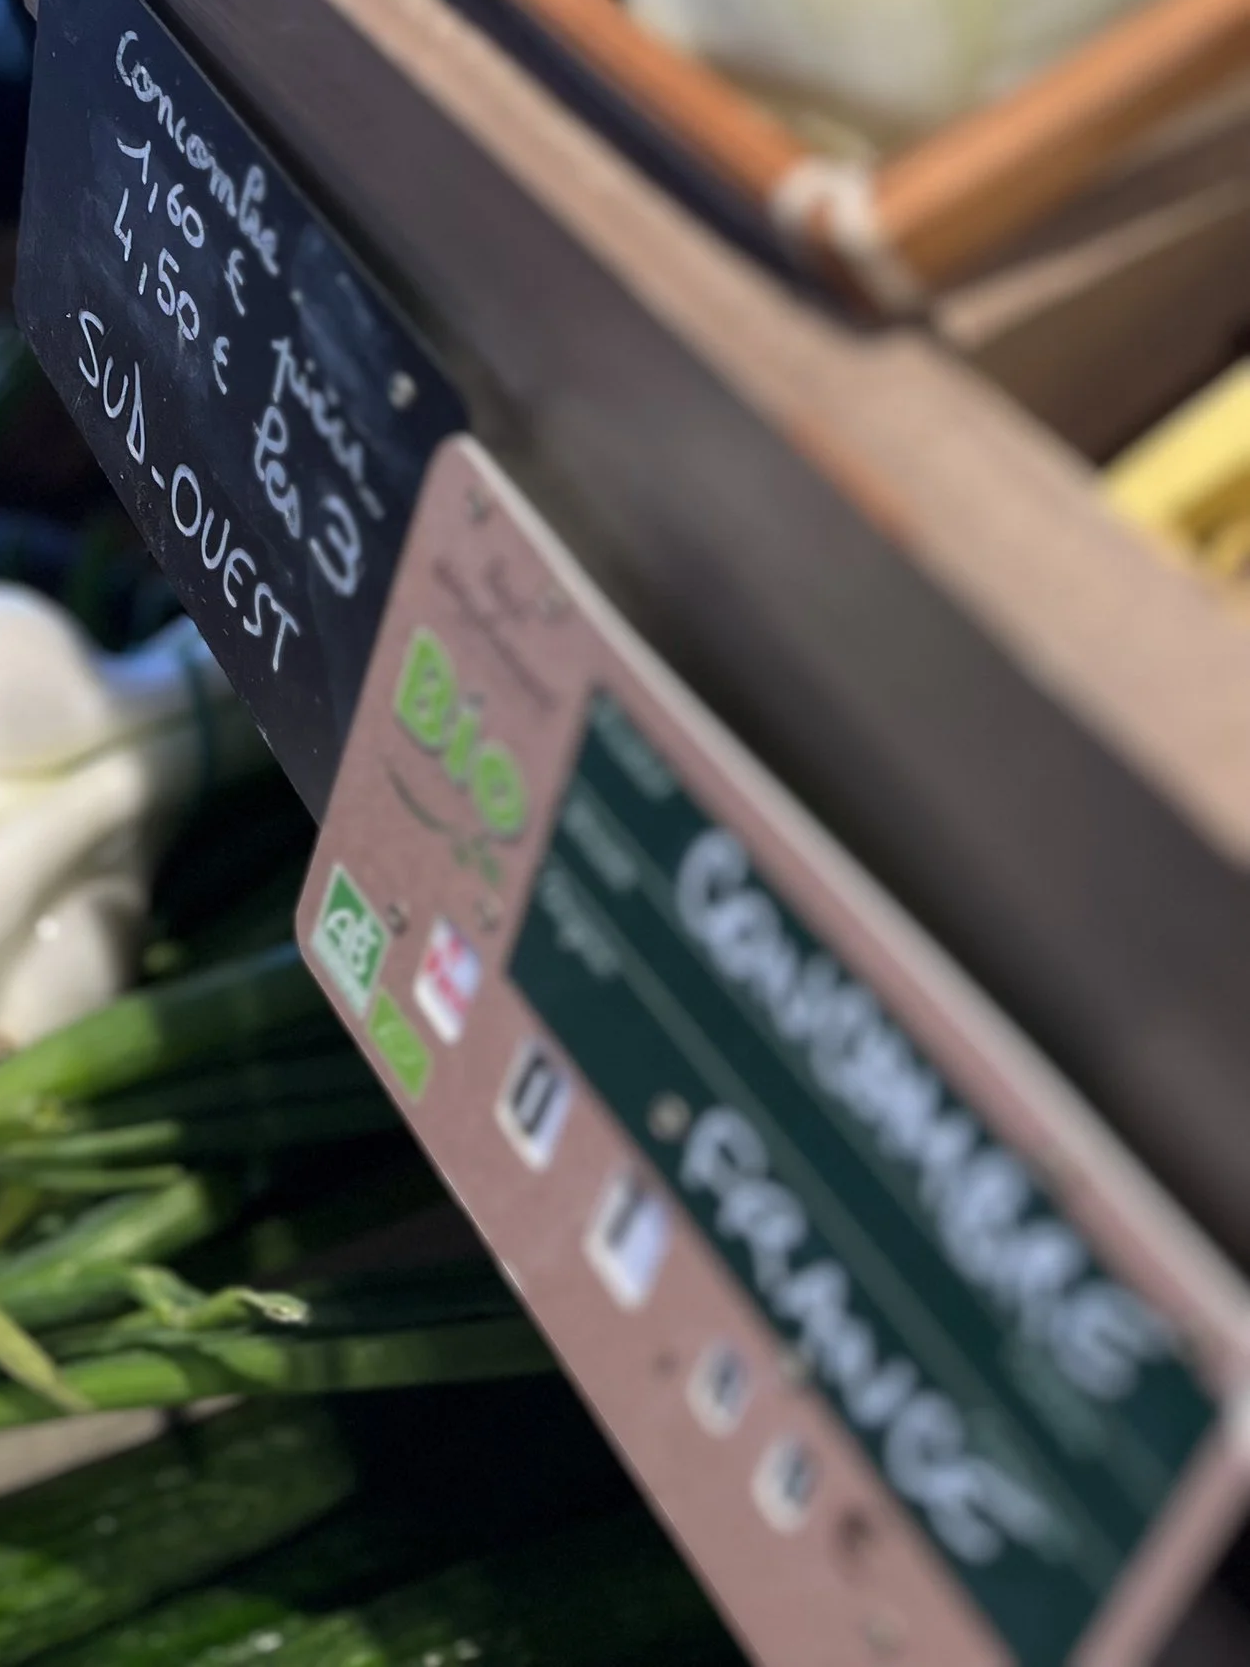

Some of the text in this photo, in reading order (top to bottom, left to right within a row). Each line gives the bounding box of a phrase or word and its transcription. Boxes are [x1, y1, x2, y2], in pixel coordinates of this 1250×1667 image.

[113, 188, 363, 597] 4,50 € les 3
[116, 138, 205, 248] 1,60
[224, 248, 245, 316] €
[78, 310, 300, 672] SUD-OUEST
[680, 1106, 1075, 1564] FRANCE
